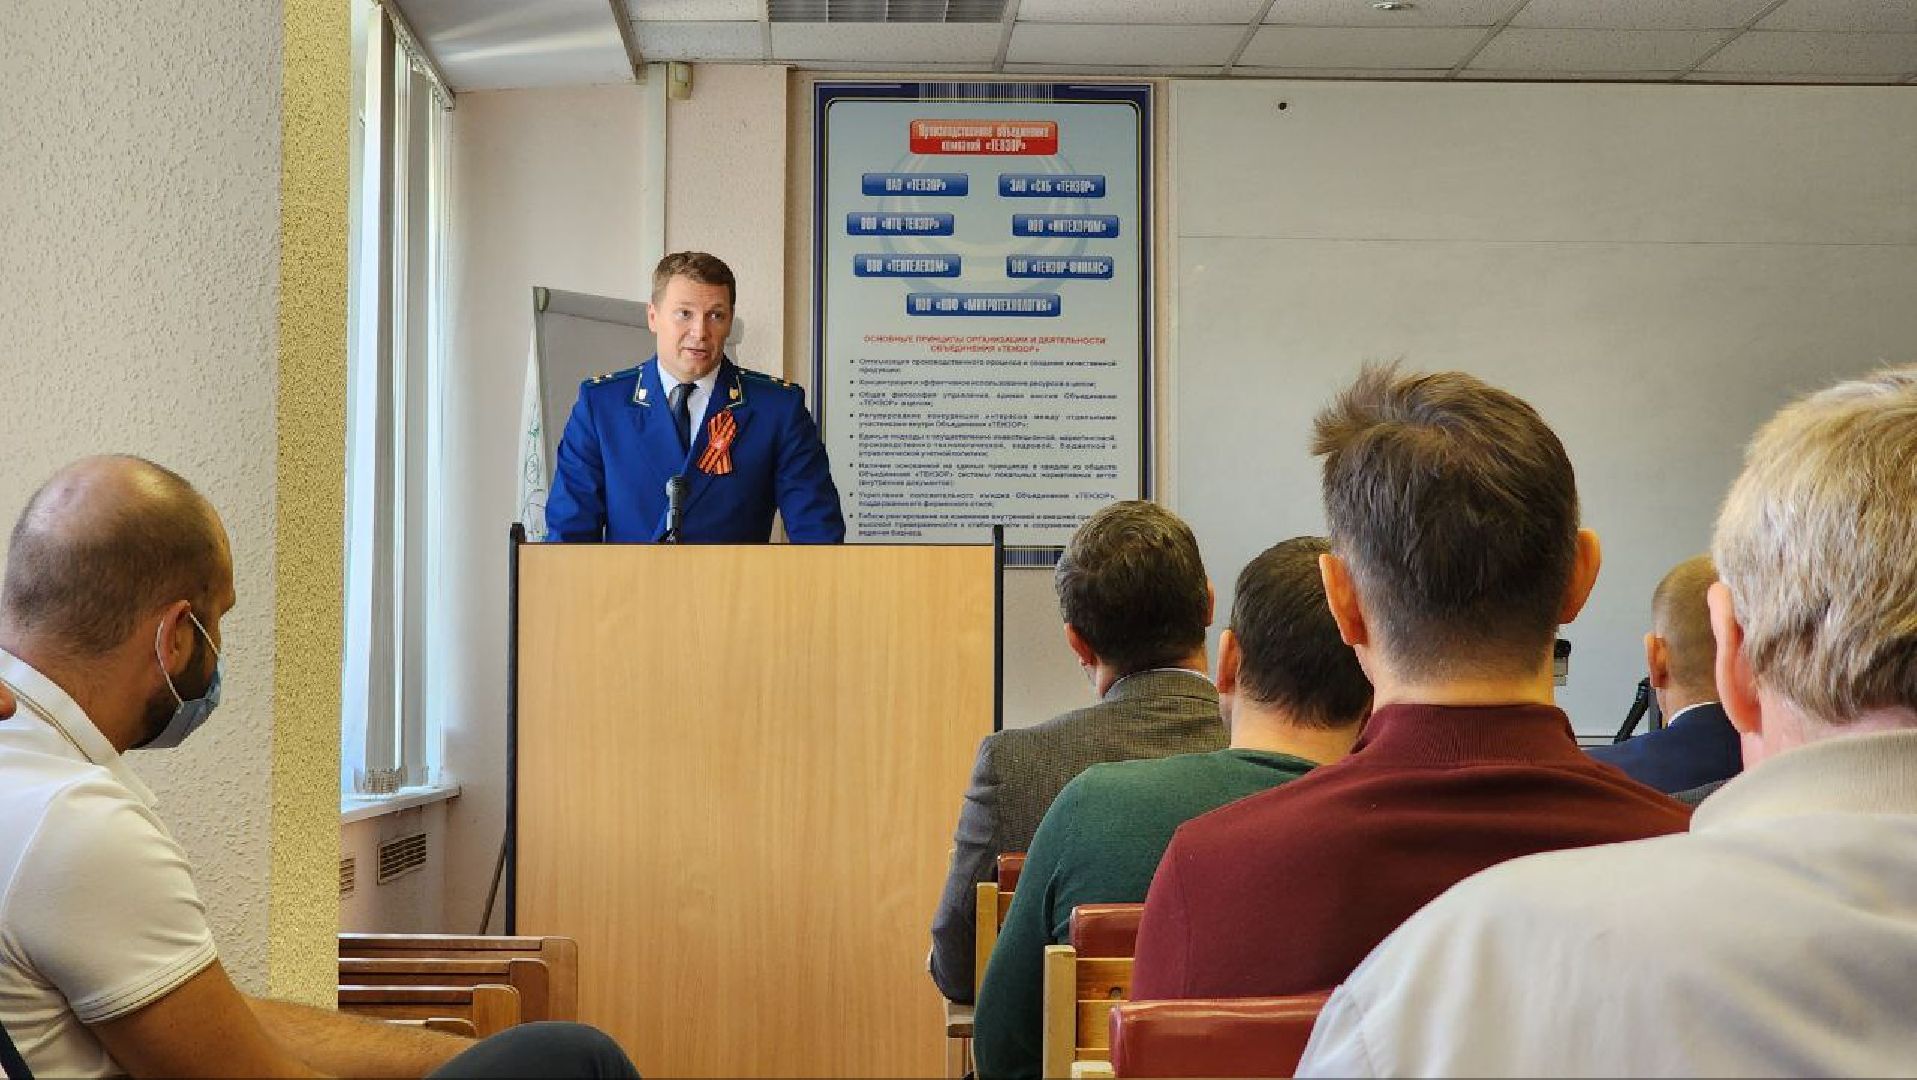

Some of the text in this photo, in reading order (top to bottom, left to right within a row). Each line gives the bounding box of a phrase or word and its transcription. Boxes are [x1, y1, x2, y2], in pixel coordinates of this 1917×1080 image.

[941, 139, 1026, 152] компаний «ТЕНЗОР»
[885, 178, 946, 191] ОАО «ТЕНЗОР»
[1010, 179, 1026, 192] ЗАО
[1056, 179, 1095, 192] «ТЕНЗОР»
[860, 217, 877, 231] ООО
[1027, 219, 1043, 232] ООО
[866, 259, 882, 272] ООО
[1011, 260, 1027, 273] ООО
[915, 298, 932, 311] ООО
[863, 335, 1106, 344] ОСНОВНЫЕ ПРИНЦИПЫ ОРГАНИЗАЦИИ И ДЕЯТЕЛЬНОСТИ
[930, 345, 1040, 353] ОБЪЕДИНЕНИЯ «ТЕНЗОР»
